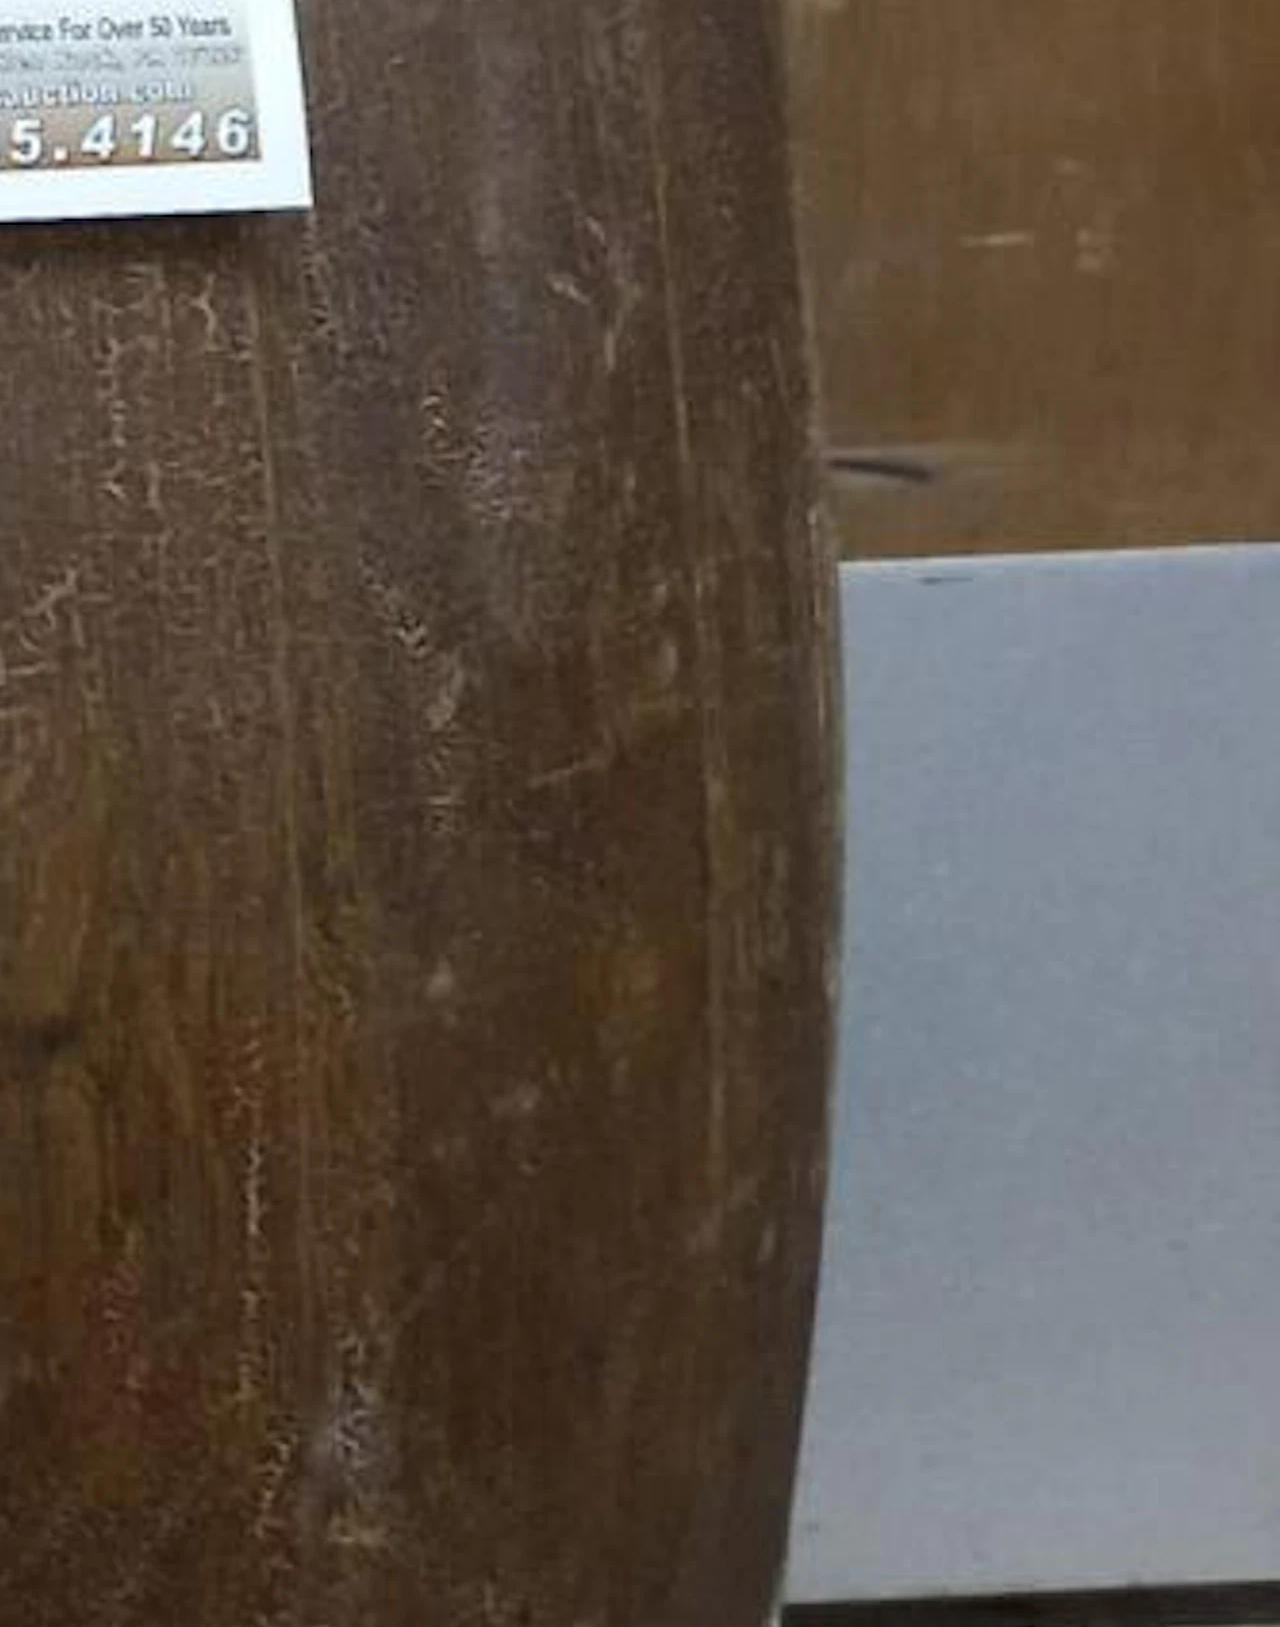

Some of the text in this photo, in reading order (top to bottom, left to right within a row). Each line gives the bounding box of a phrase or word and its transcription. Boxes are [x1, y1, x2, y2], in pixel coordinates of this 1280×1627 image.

[59, 17, 92, 40] For
[98, 17, 143, 40] Over
[178, 16, 232, 38] Years
